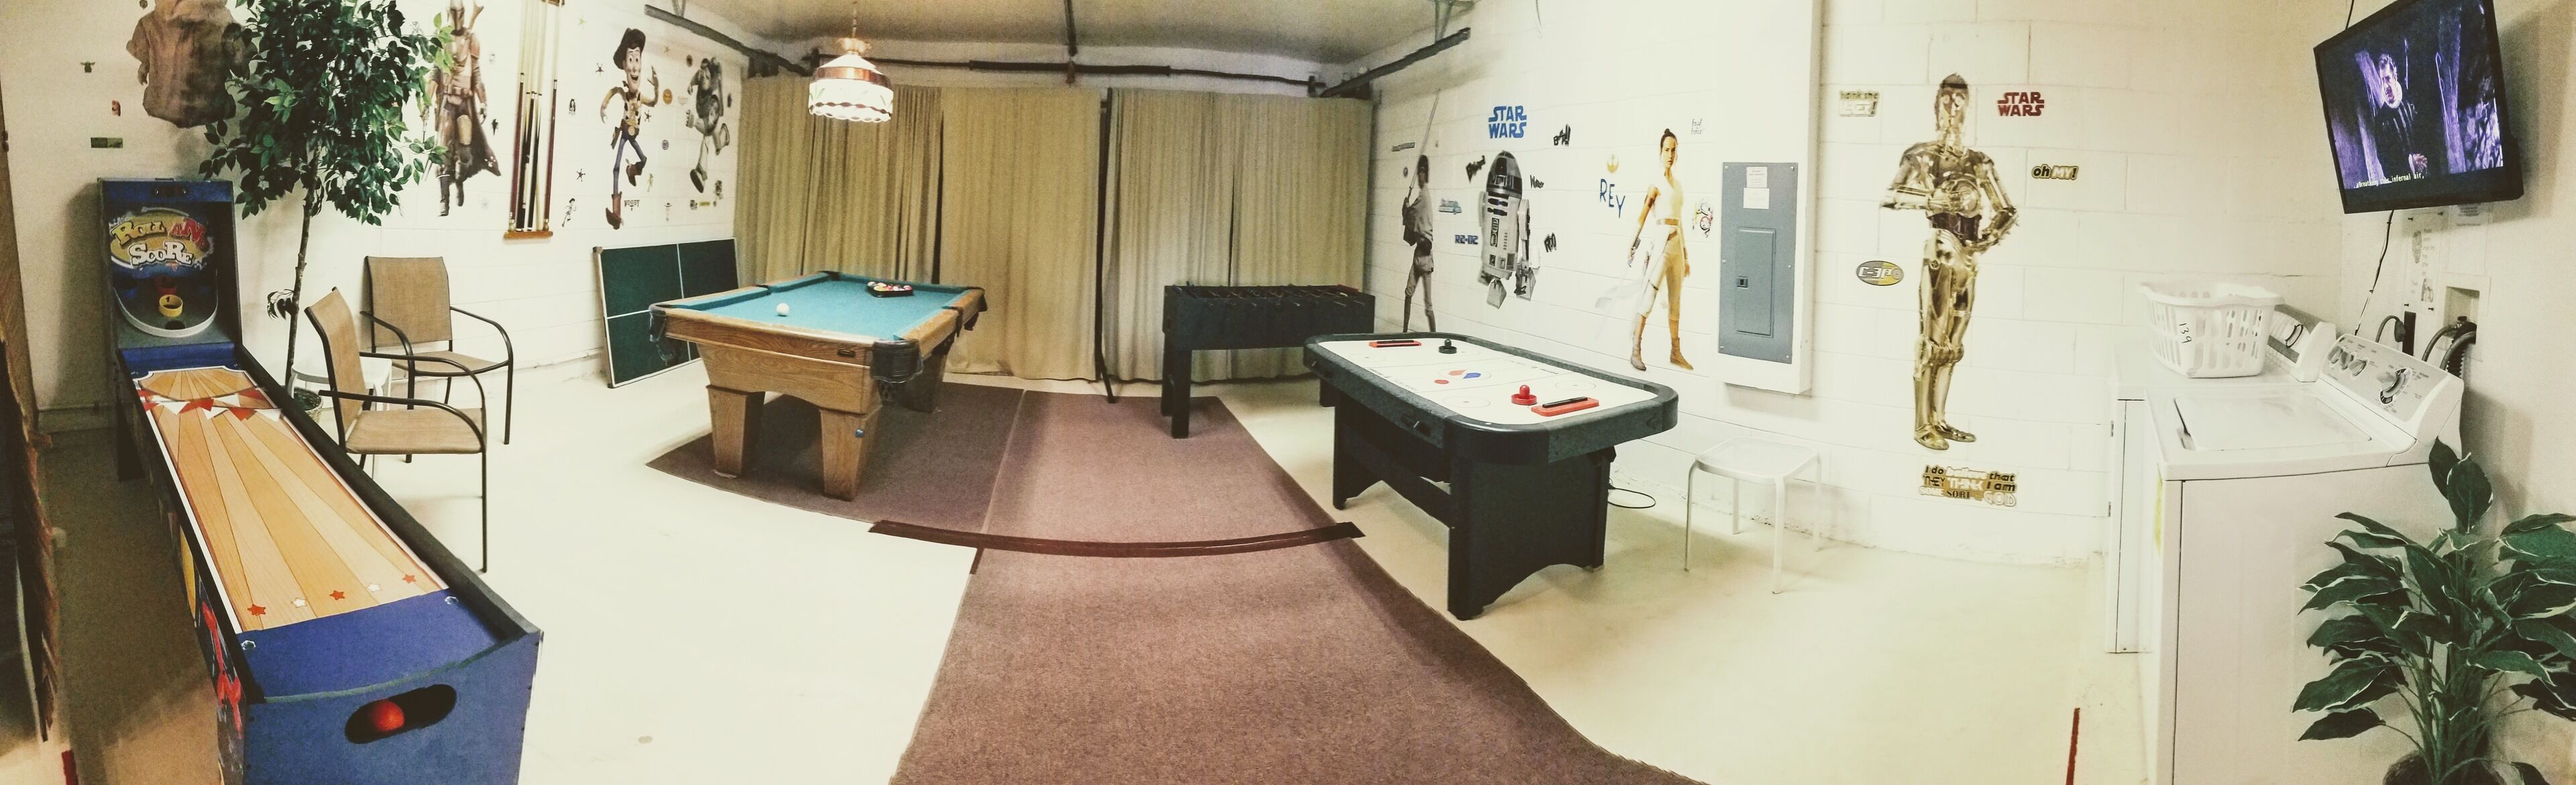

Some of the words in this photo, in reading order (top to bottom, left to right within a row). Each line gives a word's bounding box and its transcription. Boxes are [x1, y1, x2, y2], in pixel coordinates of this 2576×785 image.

[1998, 91, 2045, 104] STAR
[1489, 105, 1527, 121] STAR
[1997, 104, 2045, 116] WARS
[1489, 122, 1527, 139] WARS
[2033, 166, 2050, 176] oh
[2051, 167, 2078, 178] MY!
[2392, 173, 2411, 182] infernal
[2414, 172, 2424, 180] air,
[1599, 178, 1625, 218] REY
[111, 221, 167, 246] ROLL
[129, 242, 194, 266] SCORE
[2179, 323, 2192, 344] 139
[1931, 466, 1944, 474] do
[1990, 472, 2016, 482] that
[1994, 482, 2016, 492] am
[1947, 490, 1970, 499] SORT
[1984, 491, 2017, 507] GOD
